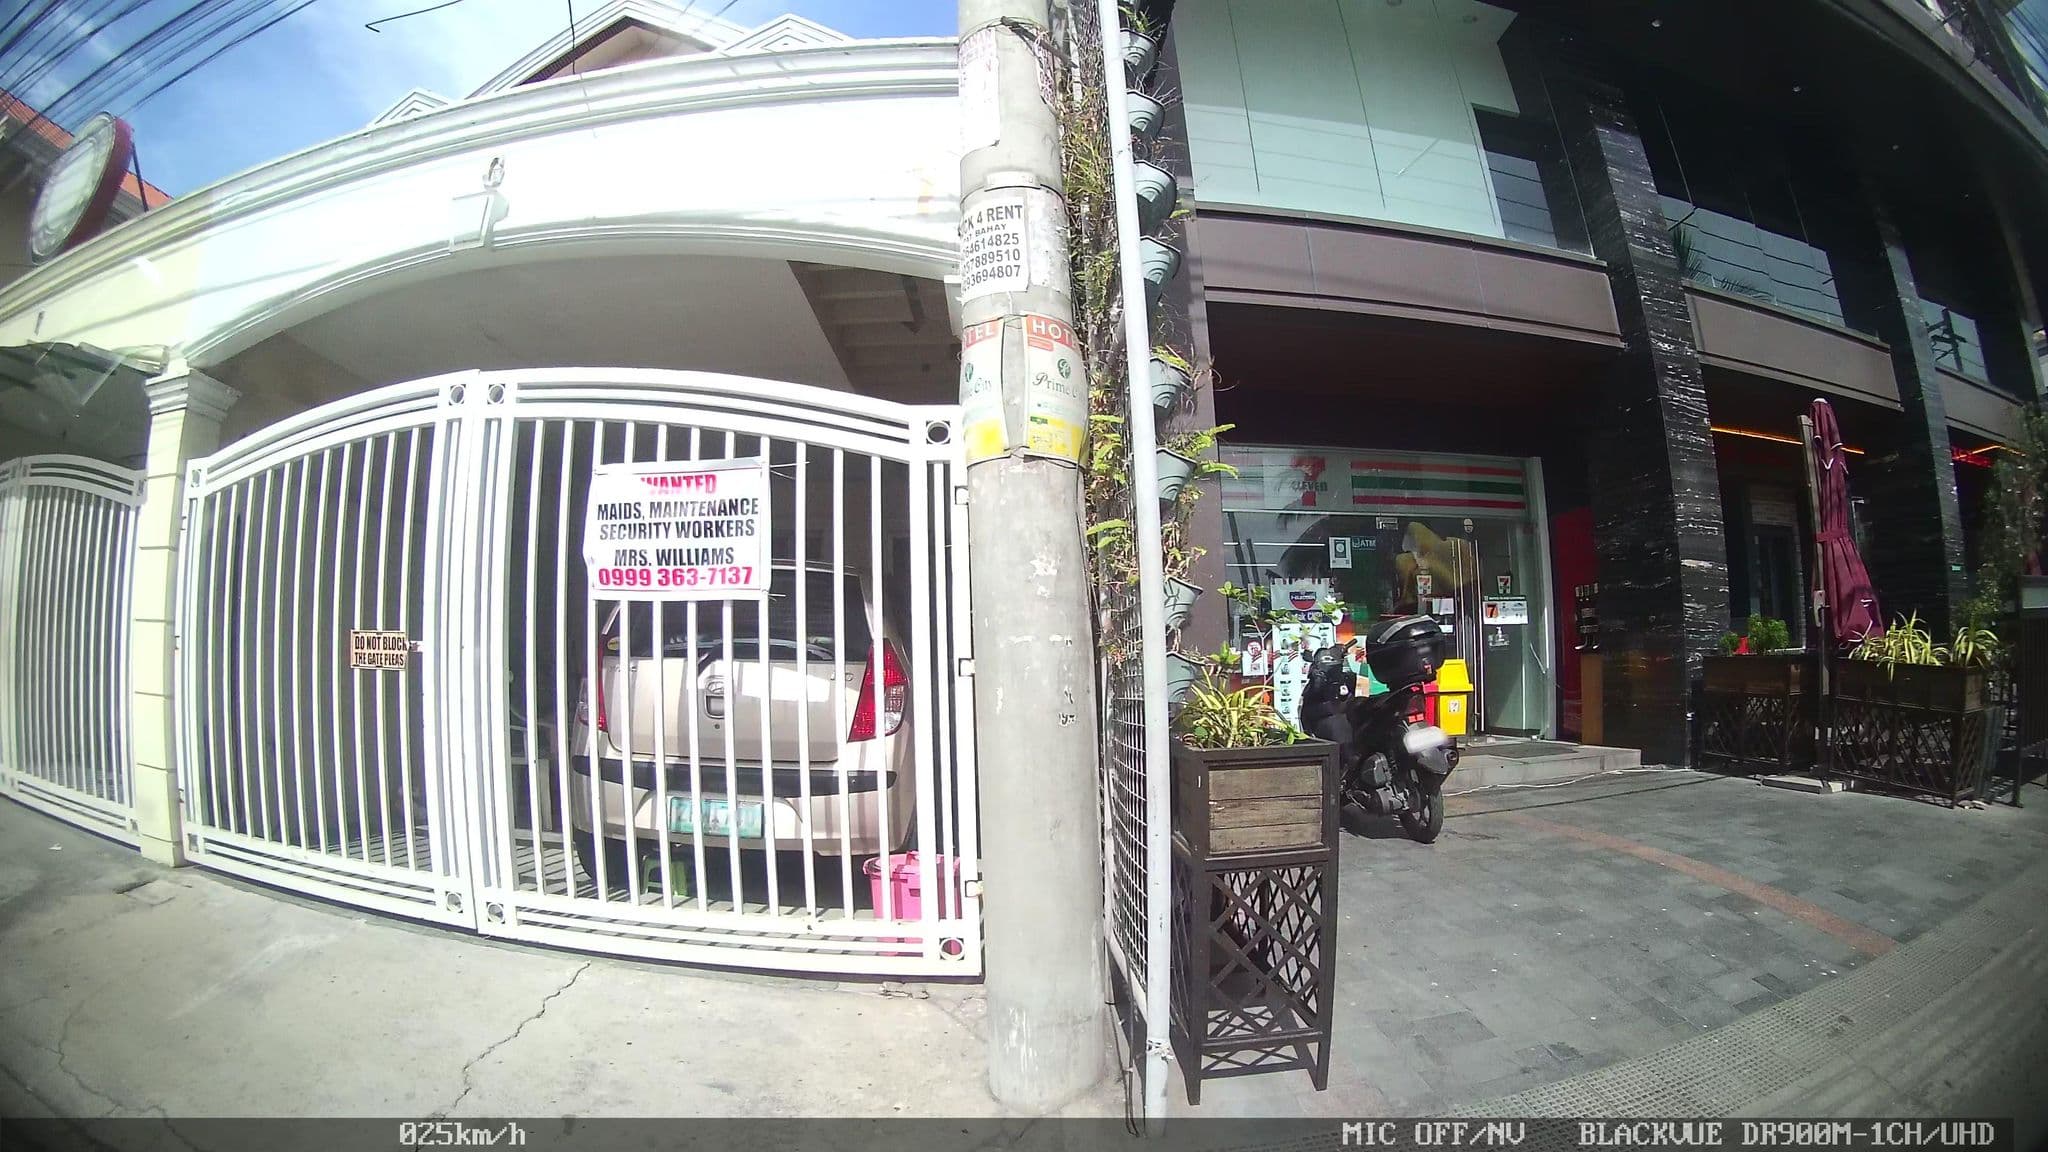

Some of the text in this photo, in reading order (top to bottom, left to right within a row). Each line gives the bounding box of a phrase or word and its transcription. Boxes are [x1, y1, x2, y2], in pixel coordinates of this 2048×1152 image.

[977, 210, 983, 224] 4
[987, 205, 1023, 222] RENT
[976, 223, 1006, 237] BAHAY
[641, 474, 717, 494] WANTED
[597, 498, 759, 520] MAIDS, MAINTENANCE
[600, 519, 755, 540] SECURITY WORKERS
[614, 547, 734, 566] MRS. WILLIAMS
[598, 566, 753, 586] 0999 363-7137
[355, 636, 408, 651] DO NOT BLOCK
[355, 652, 366, 665] THE
[368, 652, 383, 665] GATE
